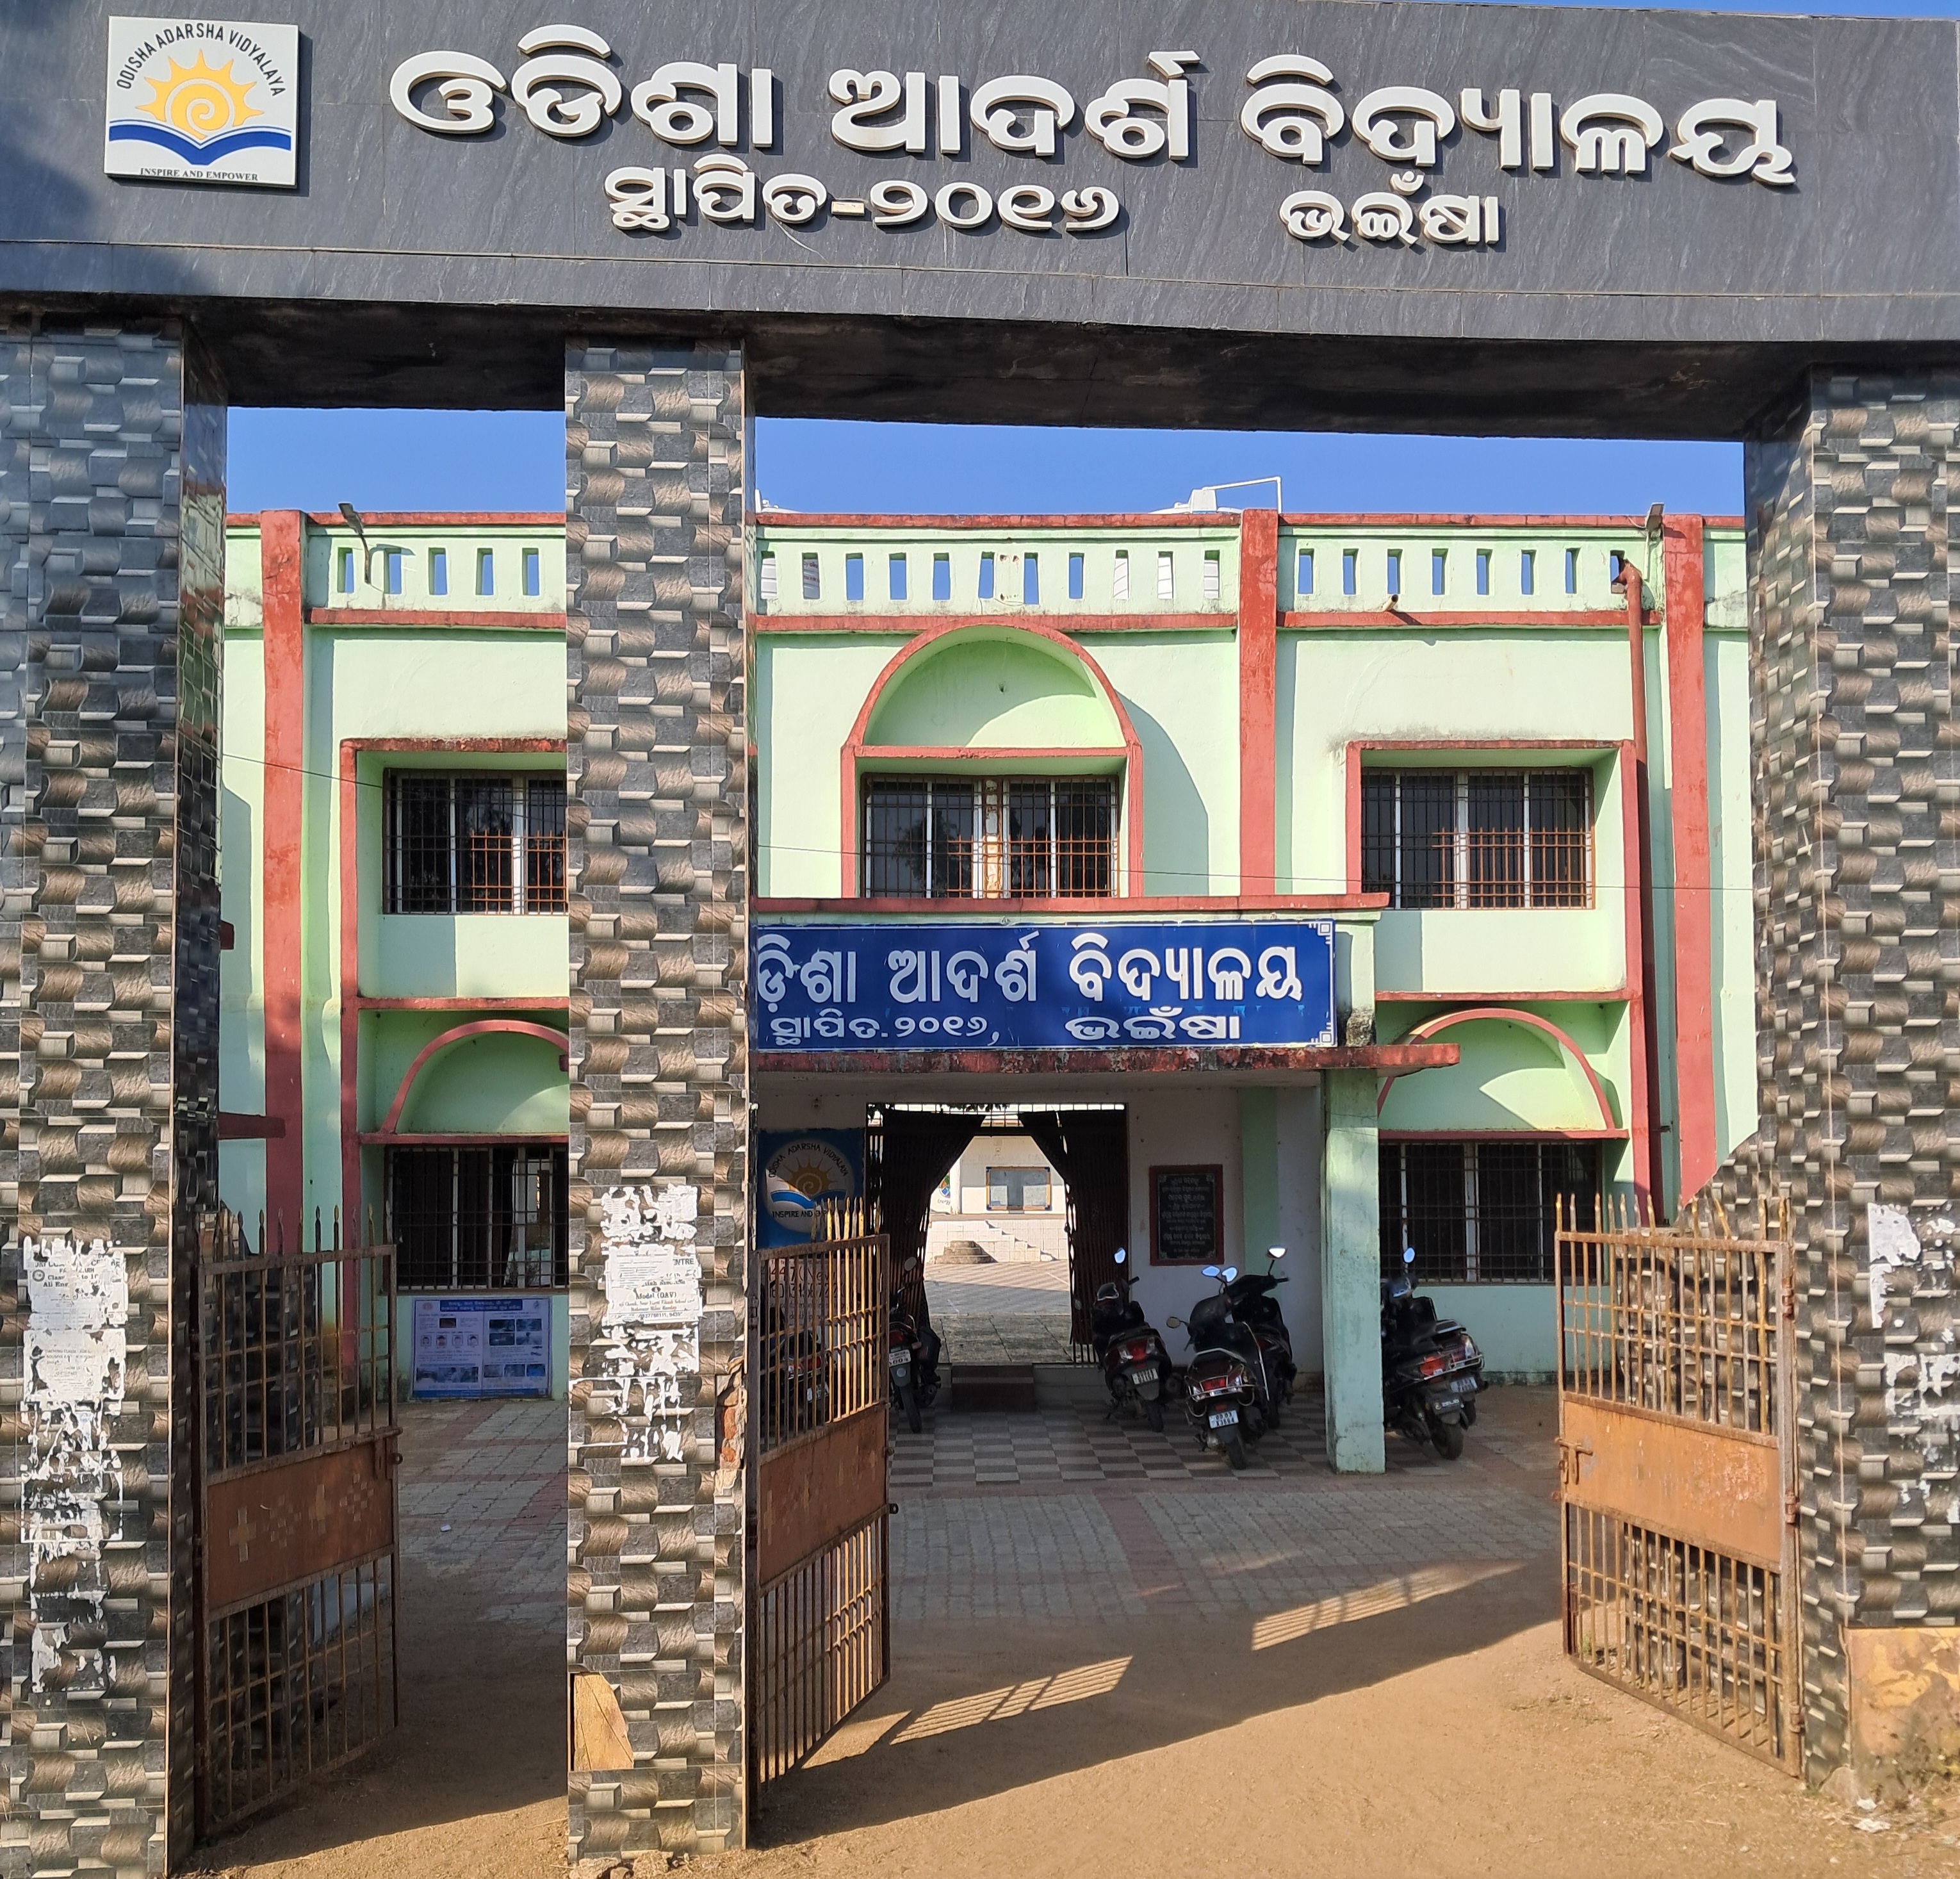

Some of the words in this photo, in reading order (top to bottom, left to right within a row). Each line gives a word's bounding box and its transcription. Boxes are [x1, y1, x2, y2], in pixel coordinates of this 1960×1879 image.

[117, 42, 157, 89] ODISHA
[155, 22, 224, 49] ADARSHA
[229, 29, 286, 96] VIDYALAYA
[829, 50, 1200, 160] ଆଦର୍ଶ
[1241, 54, 1795, 186] ବିଦ୍ୟାଳୟ
[140, 168, 180, 177] INSPIRE
[182, 170, 203, 178] AND
[206, 171, 258, 181] EMPOWER
[758, 934, 856, 1013] ଡ଼ିଶା
[888, 931, 1040, 1003] ଆଦର୍ଶ
[1069, 932, 1302, 1001] ବିଦ୍ୟାଳୟ
[787, 1143, 821, 1155] ADARSHA
